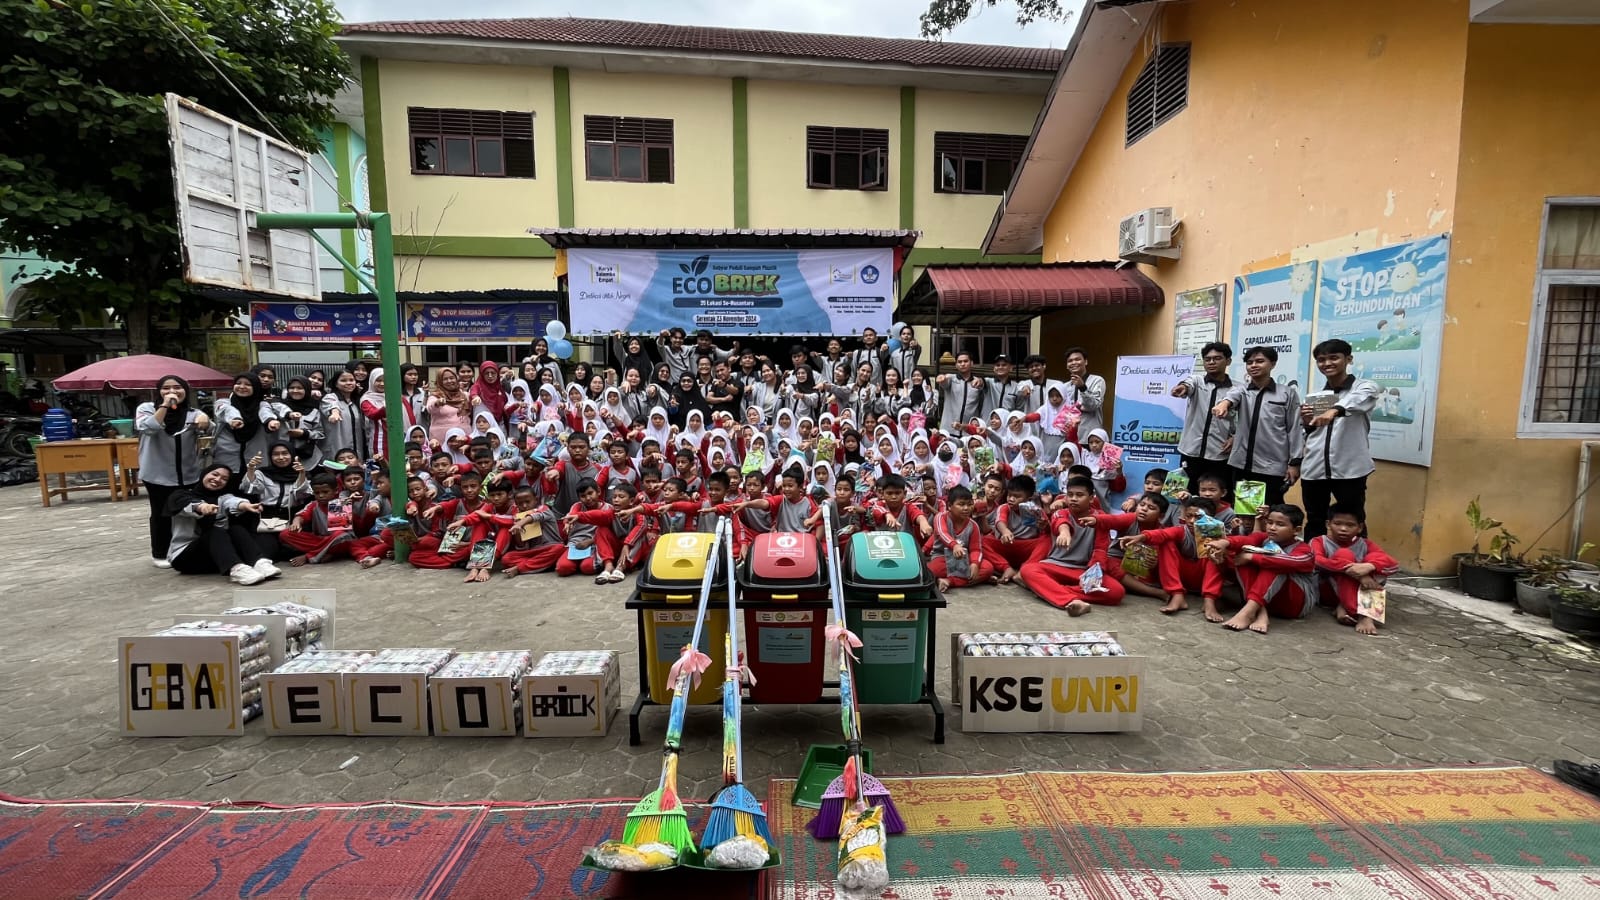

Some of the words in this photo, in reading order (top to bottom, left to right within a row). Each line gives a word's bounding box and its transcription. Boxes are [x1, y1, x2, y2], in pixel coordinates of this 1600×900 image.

[673, 277, 713, 295] ECO
[714, 273, 781, 296] BRICK
[1336, 268, 1389, 301] STOP
[1248, 305, 1267, 315] SETIAP
[1269, 302, 1292, 312] WAKTU
[1334, 293, 1420, 317] PERUNDUNGAN
[1244, 317, 1267, 326] ADALAH
[1268, 313, 1295, 323] BELAJAR
[1245, 336, 1272, 345] CAPAILAH
[1167, 364, 1191, 377] Negeri
[1114, 432, 1140, 442] ECO
[131, 663, 226, 710] GEBYAR
[970, 675, 1043, 713] KSE
[1052, 675, 1138, 713] UNRI
[287, 686, 321, 723] E
[369, 685, 402, 723] C
